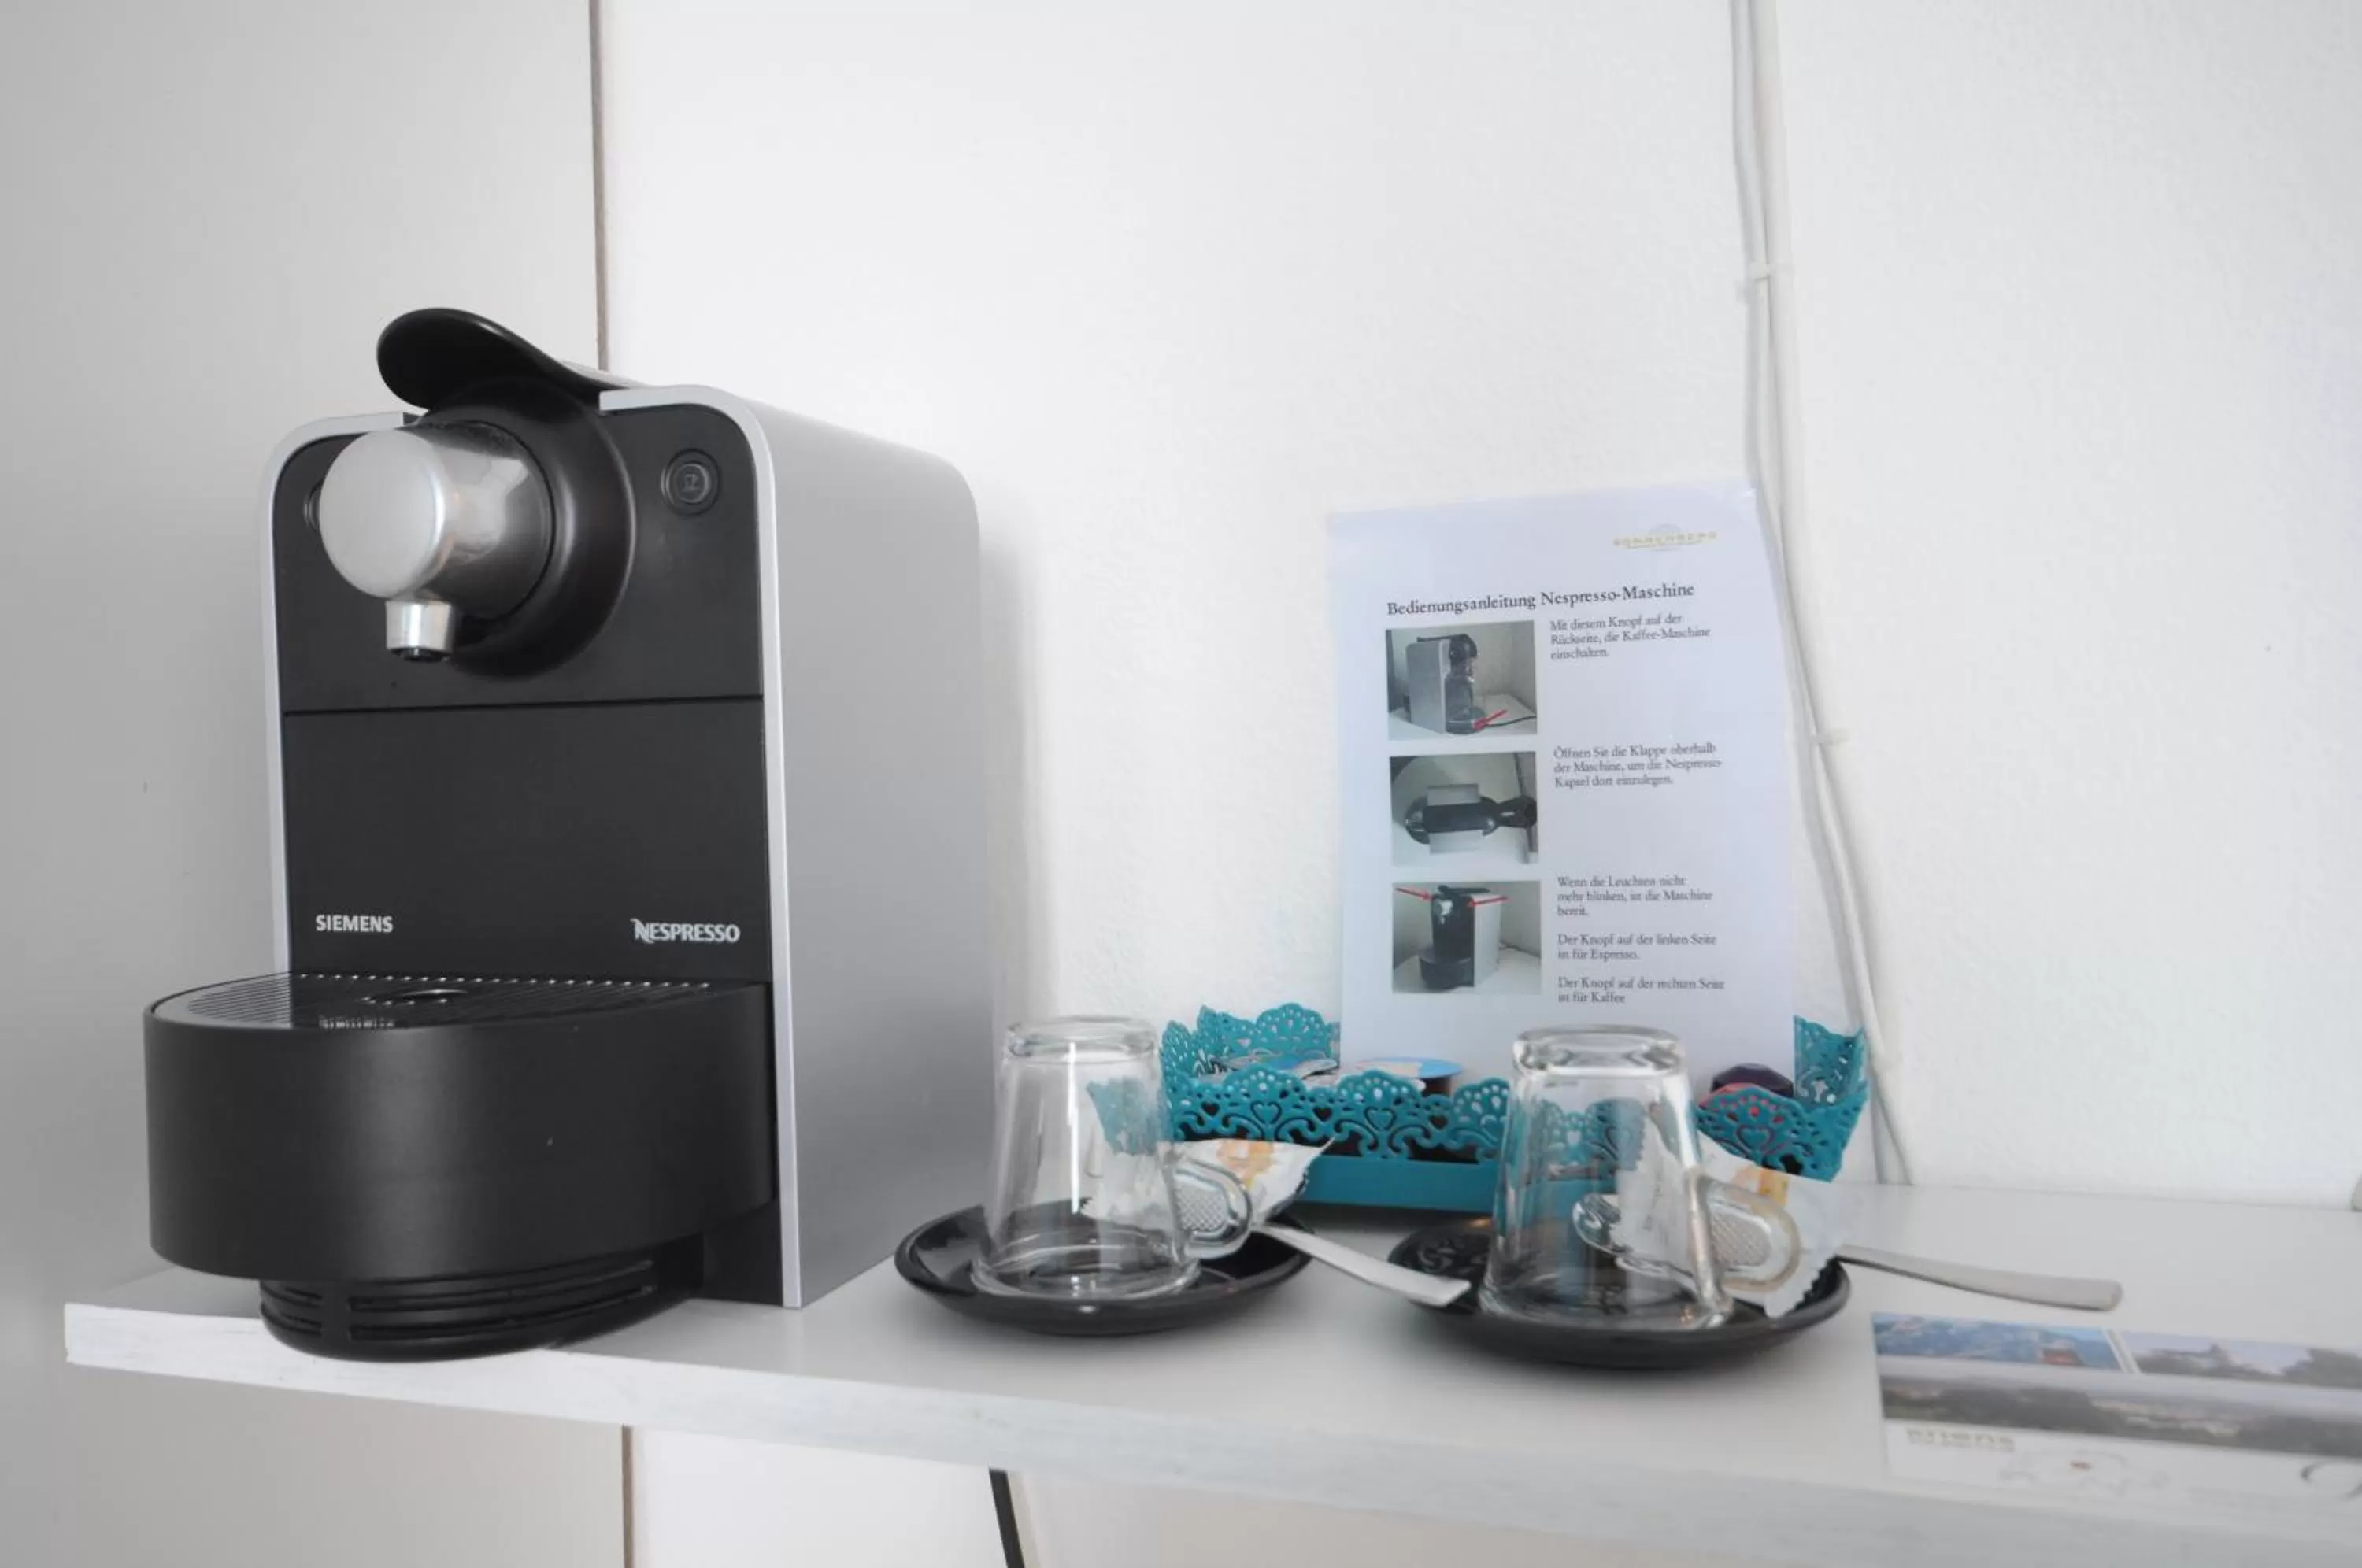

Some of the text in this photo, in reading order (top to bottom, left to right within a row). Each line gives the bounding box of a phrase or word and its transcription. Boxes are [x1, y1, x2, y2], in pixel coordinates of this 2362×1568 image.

[1386, 582, 1695, 616] Bedienungsanleitung Nespresso-Maschine
[1570, 618, 1605, 631] diesem
[1609, 616, 1642, 629] Knopf
[1646, 614, 1661, 626] auf
[1664, 612, 1683, 625] der
[1553, 741, 1717, 760] Öffnen Sie die Klappe oberhalb
[1553, 761, 1572, 773] der
[1573, 760, 1624, 773] Maschine,
[1627, 762, 1645, 771] um
[1555, 776, 1590, 790] Kapsel
[1592, 775, 1613, 787] dort
[1557, 874, 1687, 887] Wenn die Leuchten nicht
[1557, 891, 1583, 904] mehr
[1645, 890, 1660, 901] die
[1663, 889, 1713, 901] Maschine
[315, 914, 394, 934] SIEMENS
[628, 917, 742, 944] NESPRESSO
[1557, 932, 1717, 948] Der Knopf auf der linken Seite
[1572, 948, 1588, 960] für
[1557, 976, 1579, 989] Der
[1581, 976, 1616, 991] Knopf
[1617, 976, 1635, 989] auf
[1637, 976, 1653, 989] der
[1697, 977, 1725, 989] Seite
[1572, 992, 1588, 1003] für
[1590, 991, 1625, 1003] Kaffee
